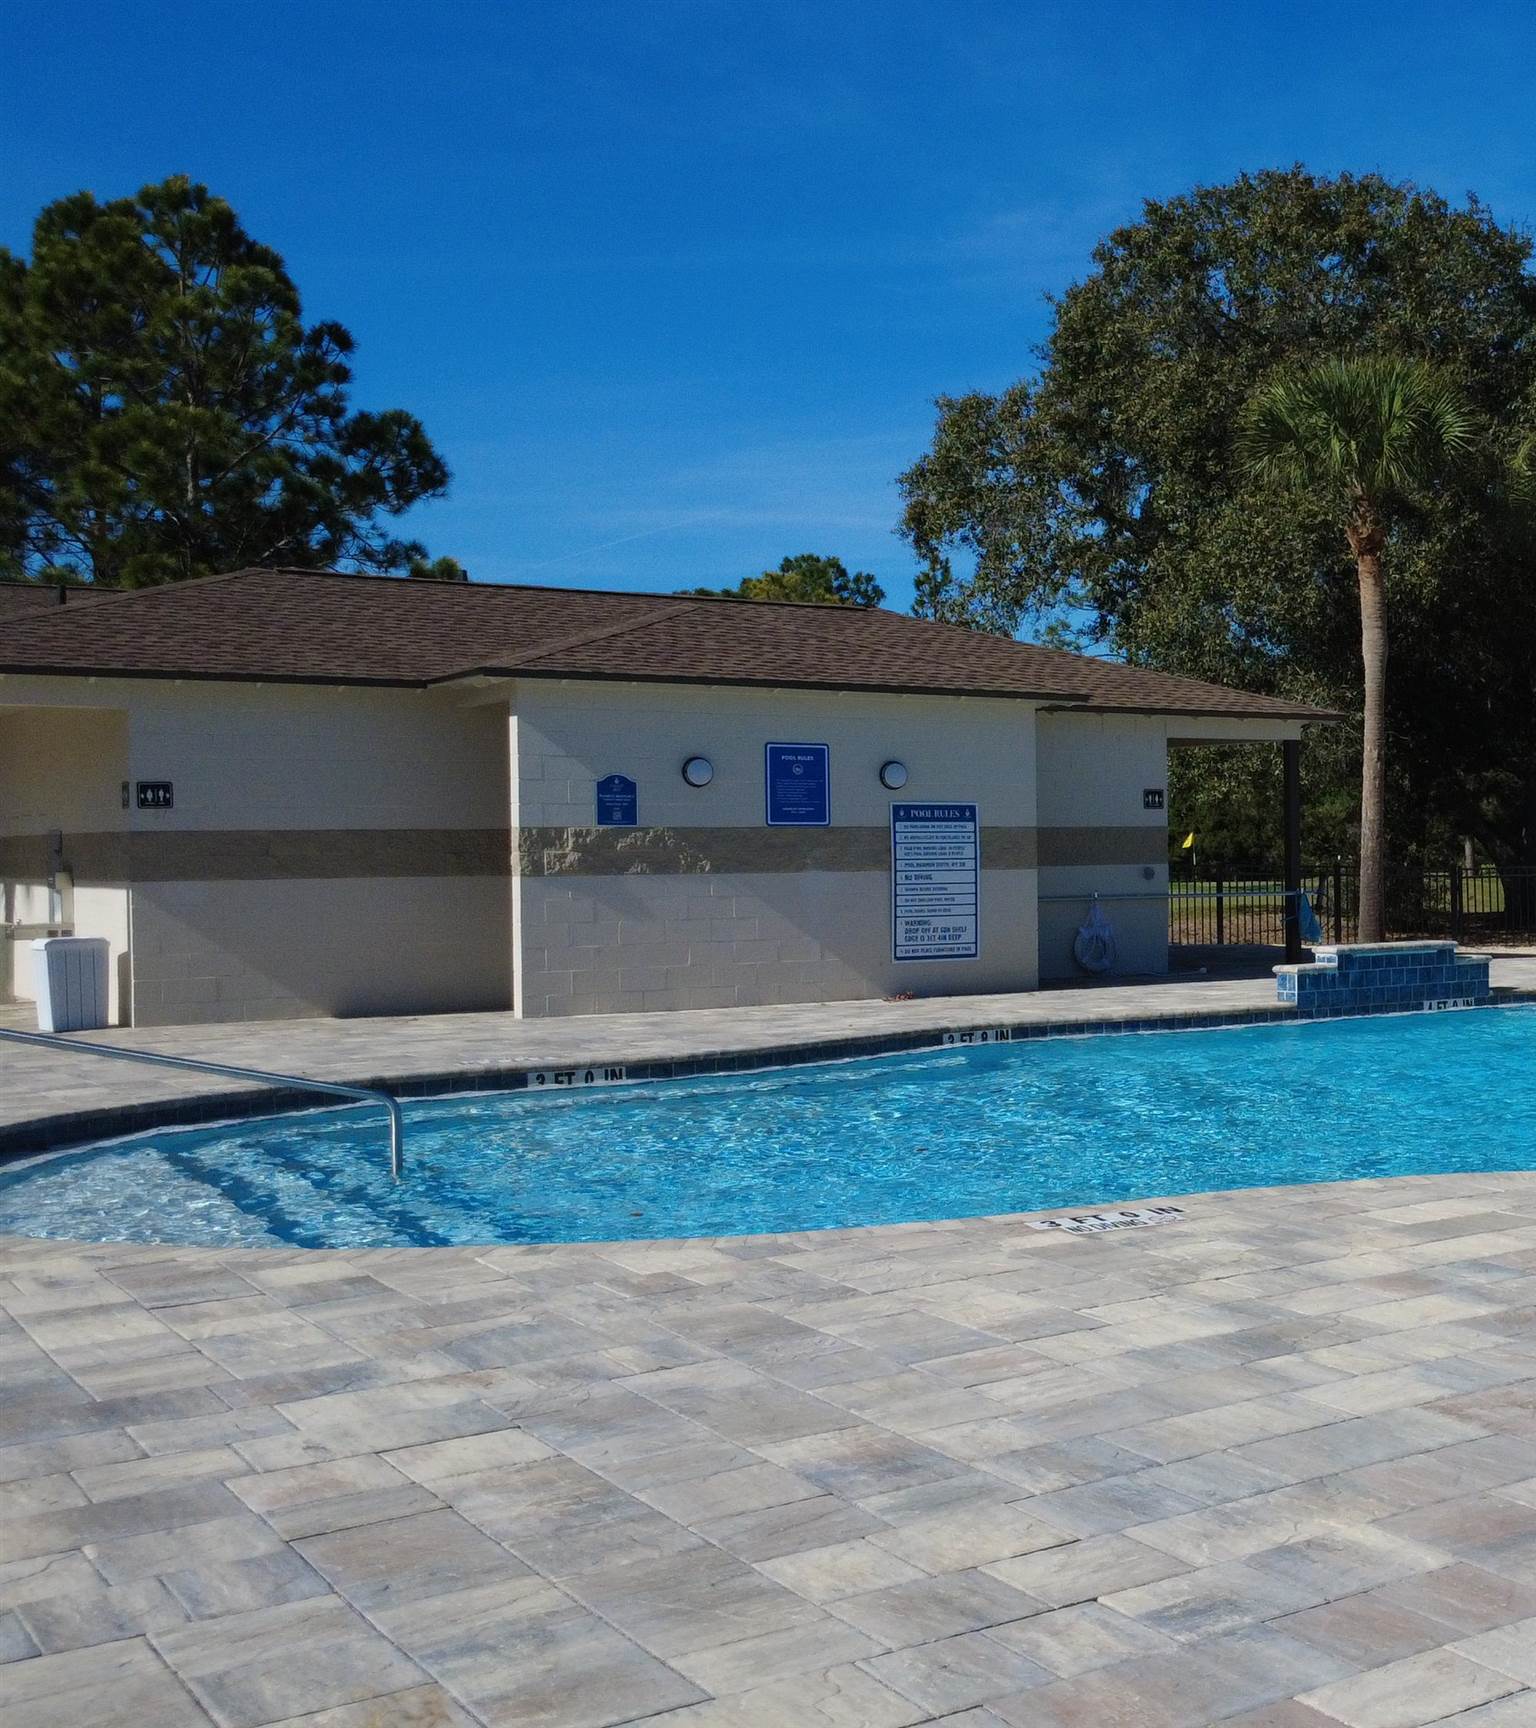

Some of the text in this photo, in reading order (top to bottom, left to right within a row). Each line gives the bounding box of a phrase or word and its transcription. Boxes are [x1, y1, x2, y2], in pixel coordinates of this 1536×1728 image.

[910, 809, 960, 818] POOL RULES
[960, 1032, 974, 1043] FT
[995, 1029, 1009, 1041] IN
[554, 1071, 576, 1085] FT
[604, 1068, 623, 1081] IN
[1069, 1214, 1107, 1224] FT
[1146, 1206, 1185, 1215] IN
[1066, 1218, 1148, 1233] NO DIVING
